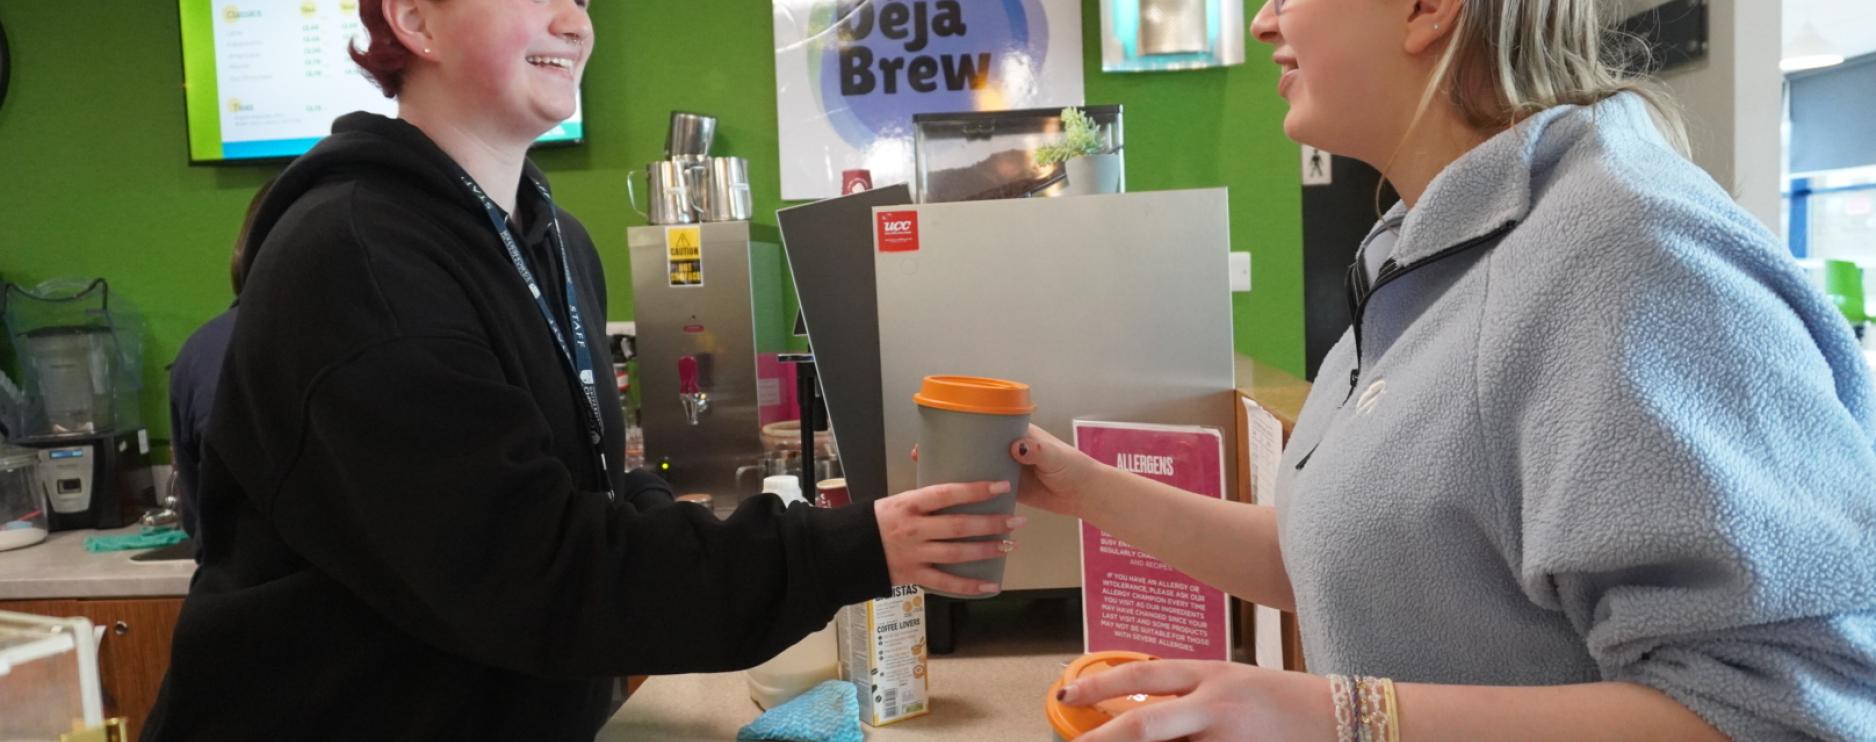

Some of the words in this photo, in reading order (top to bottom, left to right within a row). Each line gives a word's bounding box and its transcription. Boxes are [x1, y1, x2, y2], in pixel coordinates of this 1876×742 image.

[839, 46, 992, 96] Brew
[670, 247, 699, 256] CAUTION
[1117, 452, 1174, 476] ALLERGENS
[1100, 546, 1136, 557] REGULARLY
[1130, 558, 1144, 567] AND
[1129, 575, 1146, 583] HAVE
[1159, 580, 1188, 590] ALLERGY
[1102, 588, 1130, 597] ALLERGY
[1132, 592, 1166, 603] CHAMPION
[1168, 598, 1189, 607] EVERY
[1190, 602, 1205, 611] TIME
[1149, 587, 1174, 597] PLEASE
[1116, 606, 1133, 614] HAVE
[1135, 609, 1167, 620] CHANGED
[1168, 615, 1187, 624] SINCE
[1189, 620, 1207, 628] YOUR
[1119, 598, 1134, 606] VISIT
[1146, 602, 1160, 610] OUR
[1161, 606, 1204, 619] INGREDIENTS
[877, 622, 898, 633] COFFEE
[900, 617, 920, 629] LOVERS
[1101, 619, 1114, 627] MAY
[1140, 627, 1175, 638] SUITABLE
[1187, 636, 1209, 646] THOSE
[1119, 615, 1135, 623] VISIT
[1152, 621, 1170, 629] SOME
[1171, 625, 1207, 637] PRODUCTS
[1133, 633, 1156, 644] SEVERE
